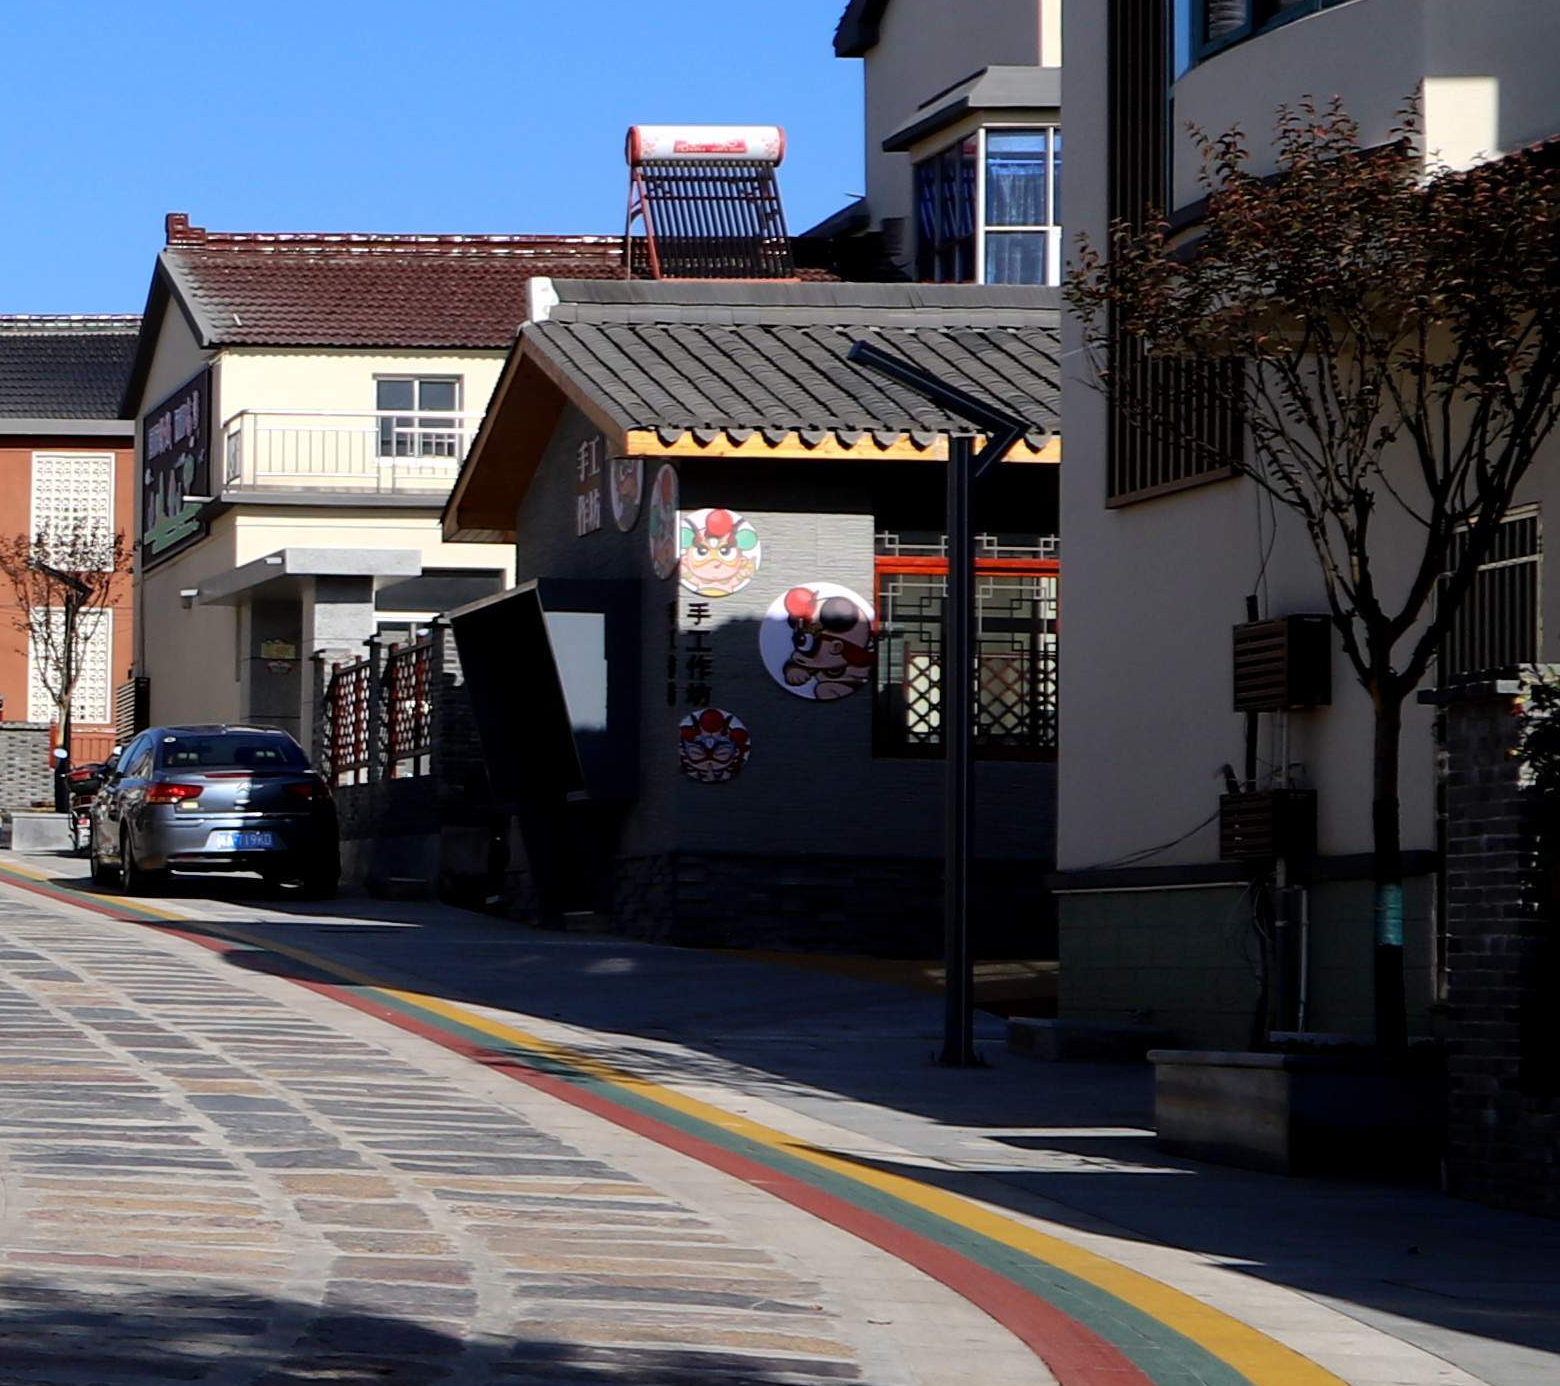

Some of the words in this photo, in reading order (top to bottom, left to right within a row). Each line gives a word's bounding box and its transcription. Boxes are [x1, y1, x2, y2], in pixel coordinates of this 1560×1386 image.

[577, 435, 600, 482] 手工
[685, 602, 712, 707] 手工作坊
